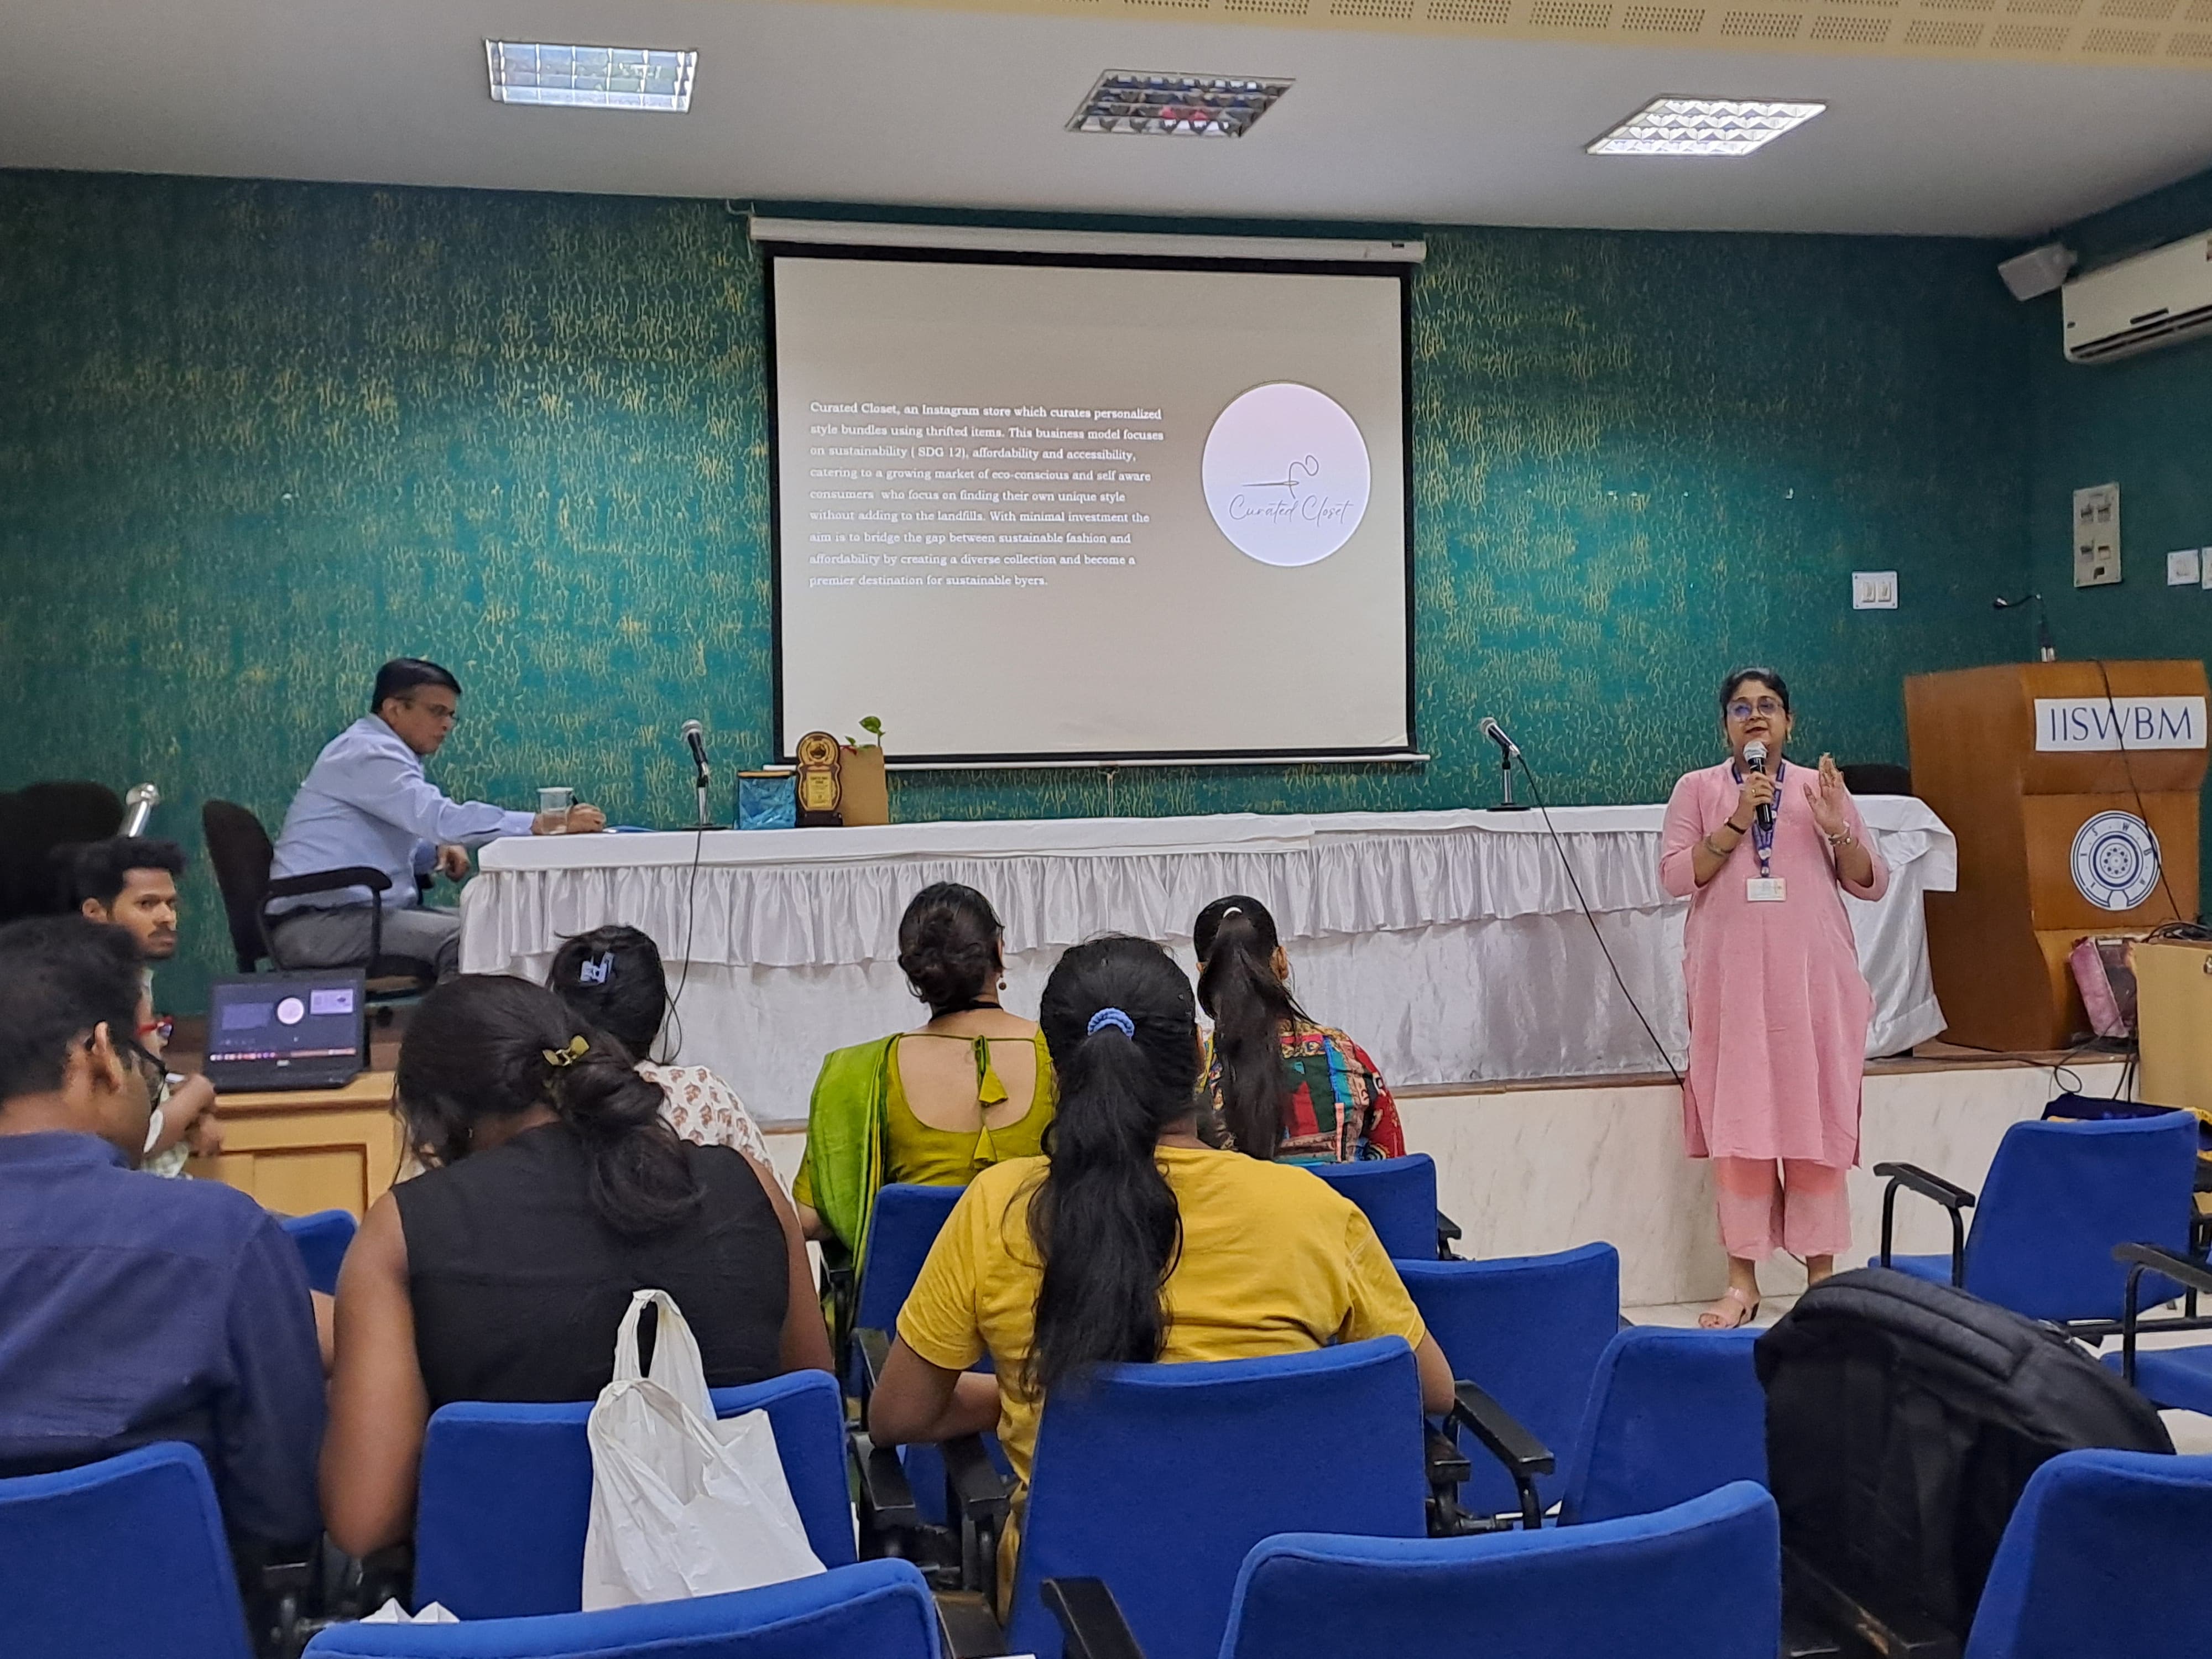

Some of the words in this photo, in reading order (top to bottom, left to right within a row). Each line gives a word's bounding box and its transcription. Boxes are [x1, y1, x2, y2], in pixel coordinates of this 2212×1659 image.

[810, 401, 858, 413] Curated
[861, 403, 901, 415] Closet,
[904, 406, 920, 415] an
[922, 404, 980, 418] Instagram
[983, 406, 1011, 417] store
[1014, 405, 1047, 418] which
[1050, 409, 1092, 419] curates
[1094, 408, 1162, 421] personalized
[811, 424, 838, 437] style
[841, 424, 888, 435] bundles
[890, 425, 924, 439] using
[926, 425, 968, 437] thrifted
[971, 426, 1005, 438] items.
[1008, 426, 1032, 439] This
[1035, 427, 1085, 439] business
[1087, 429, 1120, 440] model
[1123, 429, 1164, 441] focuses
[810, 447, 825, 456] on
[829, 446, 908, 459] sustainability
[972, 447, 1040, 461] affordability
[1042, 448, 1064, 460] and
[1066, 449, 1136, 463] accessibility,
[810, 467, 858, 479] catering
[860, 469, 872, 477] to
[886, 468, 932, 481] growing
[935, 468, 975, 479] market
[978, 468, 990, 479] of
[992, 470, 1070, 481] eco-conscious
[1072, 469, 1094, 481] and
[1097, 470, 1117, 481] self
[1118, 473, 1151, 482] aware
[881, 489, 905, 499] who
[909, 489, 940, 500] focus
[942, 492, 957, 500] on
[960, 489, 1000, 503] finding
[1002, 490, 1029, 502] their
[1031, 493, 1055, 502] own
[1058, 491, 1097, 504] unique
[1100, 491, 1125, 504] style
[810, 509, 854, 520] without
[858, 510, 898, 523] adding
[901, 512, 912, 520] to
[916, 510, 935, 521] the
[937, 510, 986, 521] landfills.
[990, 511, 1016, 521] With
[1019, 511, 1065, 522] minimal
[1068, 512, 1129, 523] investment
[1131, 512, 1150, 523] the
[1229, 494, 1298, 523] Curated
[1301, 495, 1354, 526] Closet
[810, 531, 831, 542] aim
[836, 532, 846, 542] is
[849, 534, 860, 542] to
[864, 531, 900, 545] bridge
[904, 532, 922, 542] the
[925, 535, 946, 545] gap
[949, 532, 996, 543] between
[999, 533, 1063, 543] sustainable
[1066, 532, 1107, 544] fashion
[1110, 533, 1131, 544] and
[810, 554, 880, 566] affordability
[883, 554, 898, 566] by
[900, 554, 947, 566] creating
[961, 554, 1001, 565] diverse
[1004, 554, 1057, 565] collection
[1059, 554, 1081, 565] and
[1084, 554, 1126, 565] become
[810, 575, 855, 588] premier
[858, 575, 924, 585] destination
[927, 575, 943, 585] for
[946, 575, 1011, 585] sustainable
[1014, 575, 1048, 588] byers.
[2051, 706, 2191, 741] IISWBM
